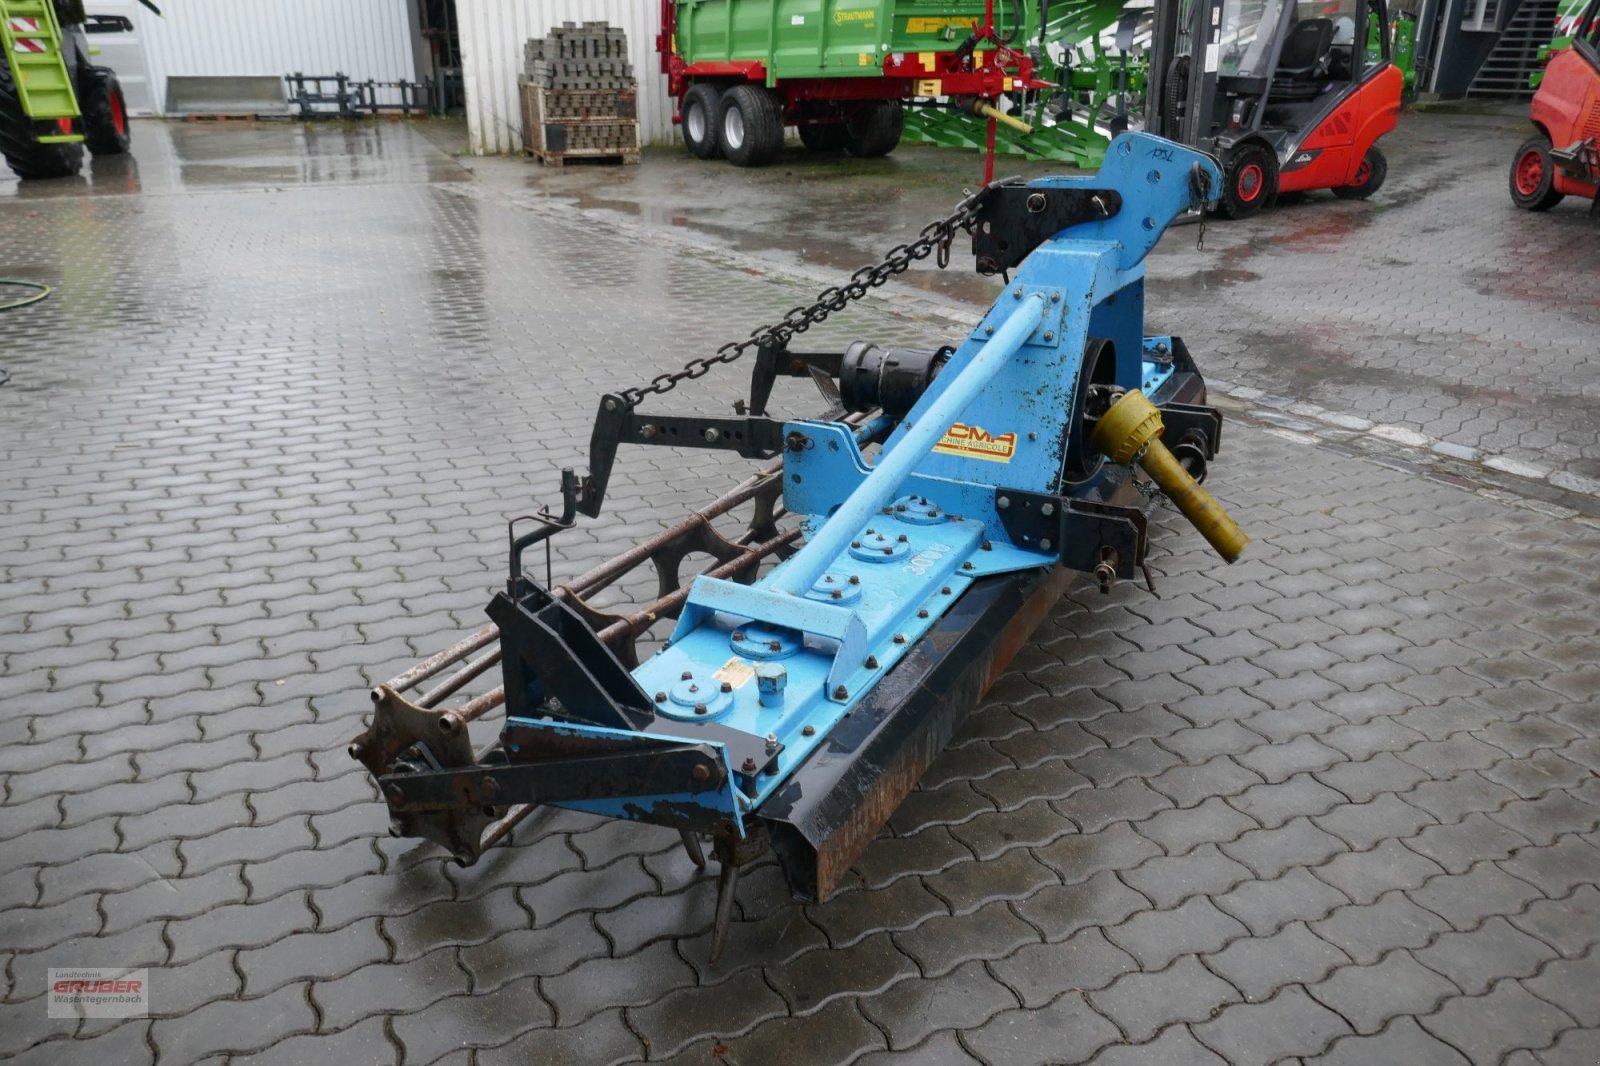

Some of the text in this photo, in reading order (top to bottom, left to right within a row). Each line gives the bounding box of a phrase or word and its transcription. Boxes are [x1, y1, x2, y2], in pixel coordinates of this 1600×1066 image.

[836, 9, 875, 22] STRAUTMANN
[940, 436, 1008, 452] CHINE AGRICOLE
[947, 423, 1015, 447] CMA
[902, 543, 951, 576] 3000
